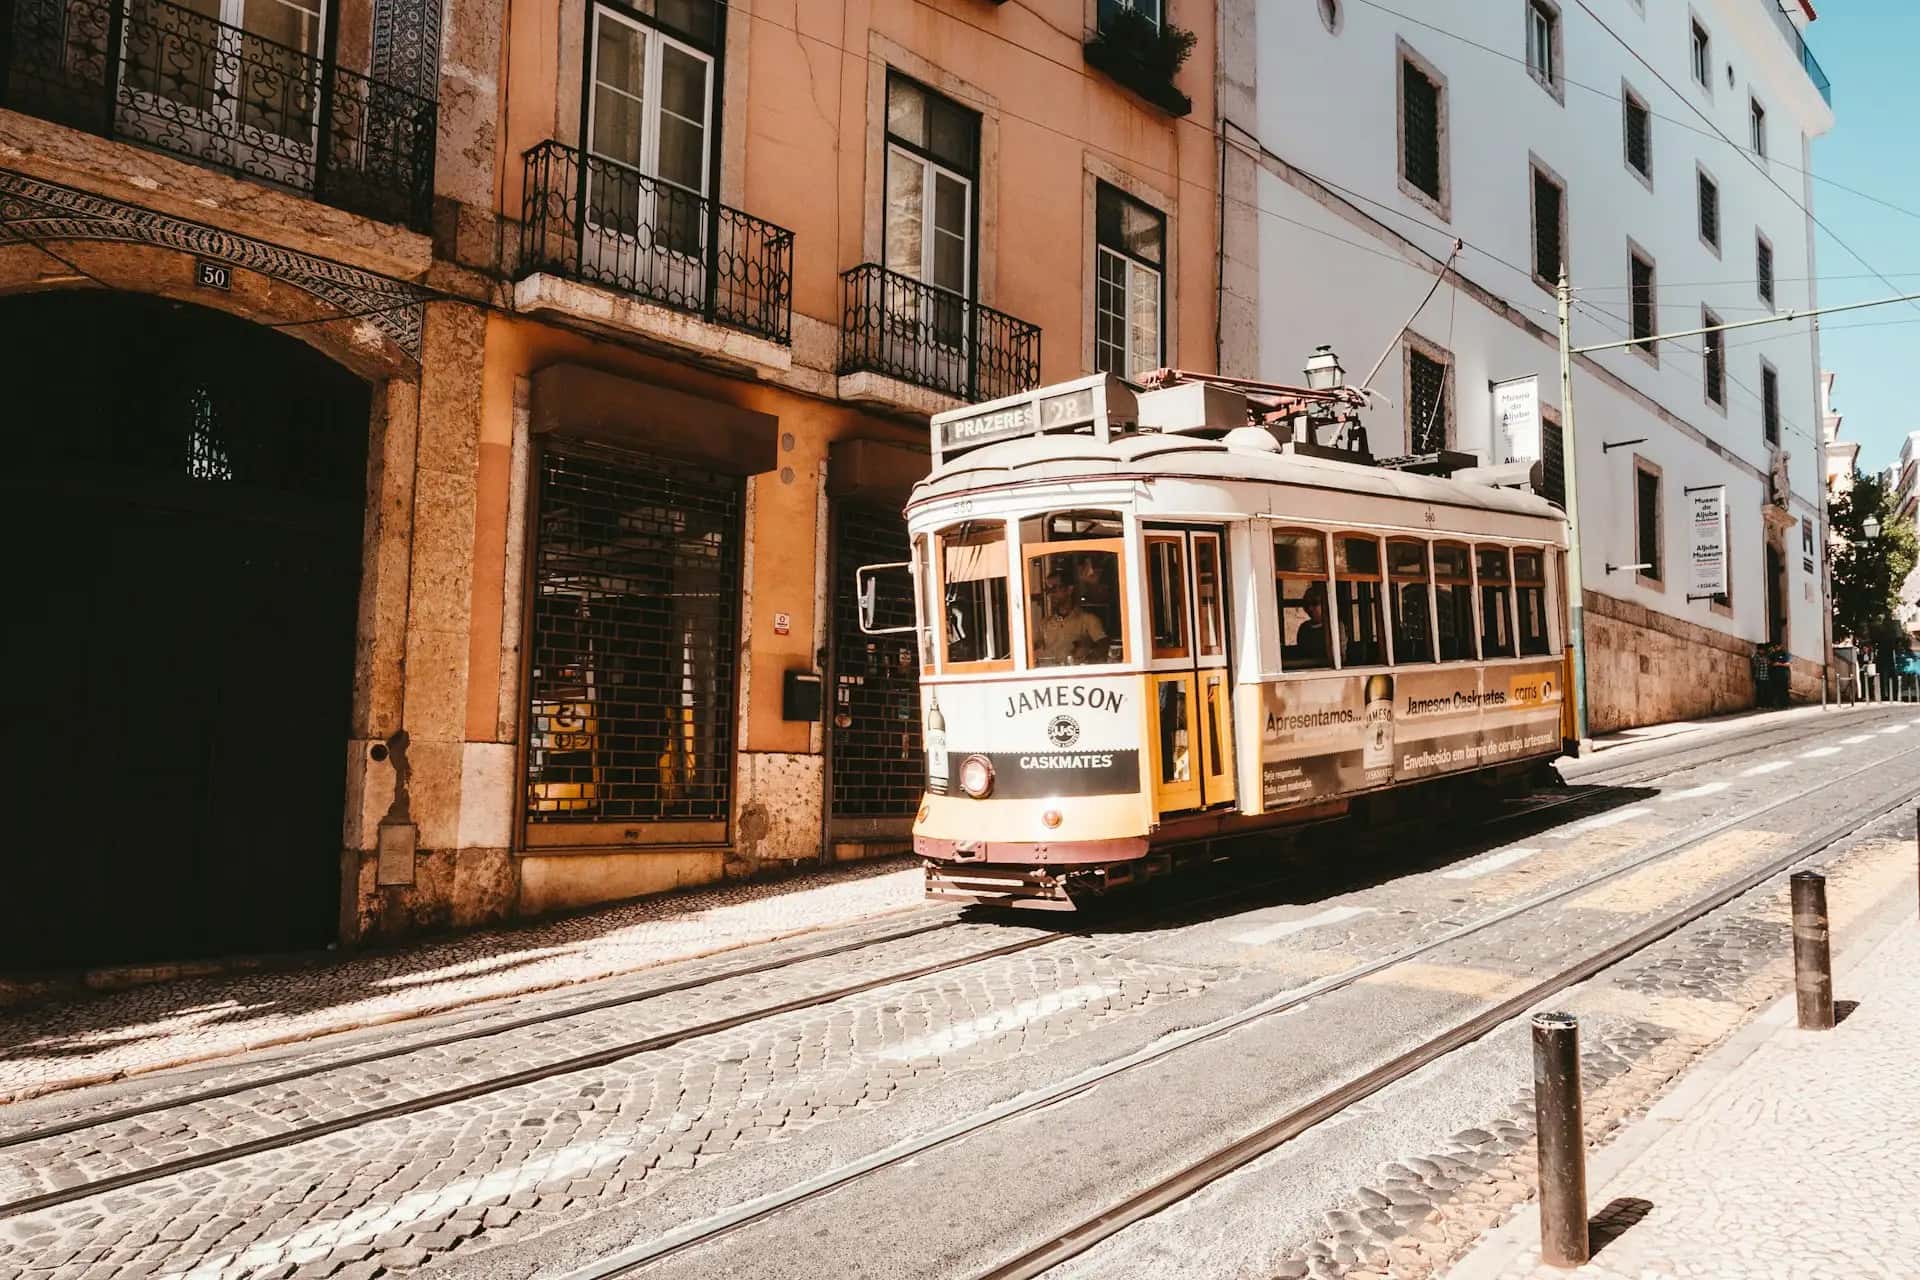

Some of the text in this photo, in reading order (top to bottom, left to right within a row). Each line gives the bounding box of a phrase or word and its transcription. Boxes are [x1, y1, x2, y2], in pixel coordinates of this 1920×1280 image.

[204, 266, 225, 286] 50
[1051, 399, 1078, 421] 28
[955, 408, 1034, 438] PRAZERES
[1696, 511, 1718, 519] Aljube
[1005, 685, 1123, 718] JAMESON
[1407, 697, 1451, 715] Jameson
[1266, 708, 1362, 736] Apresentamos...
[1020, 755, 1113, 769] CASKMATES
[1404, 749, 1451, 770] Envelhecido
[1452, 749, 1465, 761] em
[1488, 741, 1497, 754] de
[1498, 736, 1523, 752] cerveja
